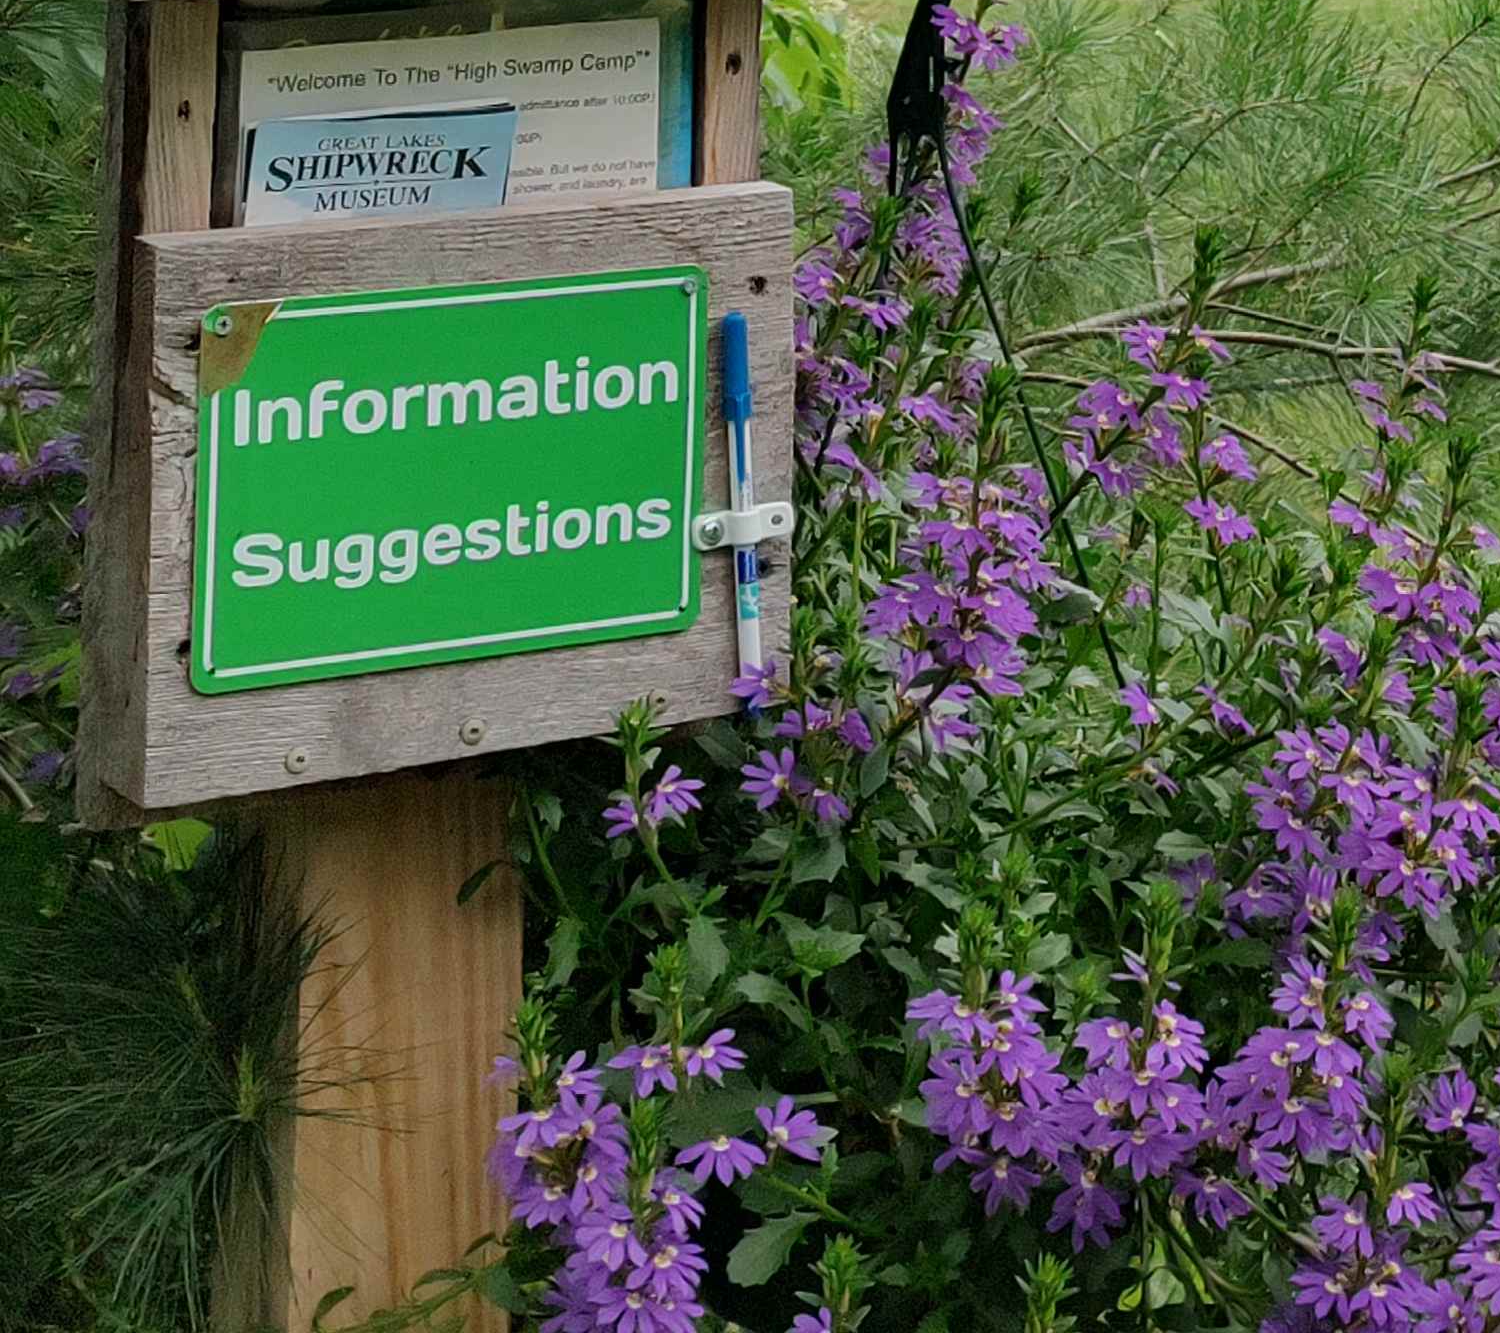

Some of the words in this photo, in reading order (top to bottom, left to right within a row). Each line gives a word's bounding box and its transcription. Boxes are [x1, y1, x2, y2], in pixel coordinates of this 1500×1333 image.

[373, 67, 398, 86] To
[404, 66, 441, 84] The
[503, 57, 574, 76] Swamp
[317, 135, 380, 152] GREAT
[385, 132, 447, 148] LAKES
[265, 145, 492, 193] SHIPWRECK
[313, 185, 432, 212] MUSEUM
[233, 356, 680, 447] Information
[231, 497, 672, 589] Suggestions
